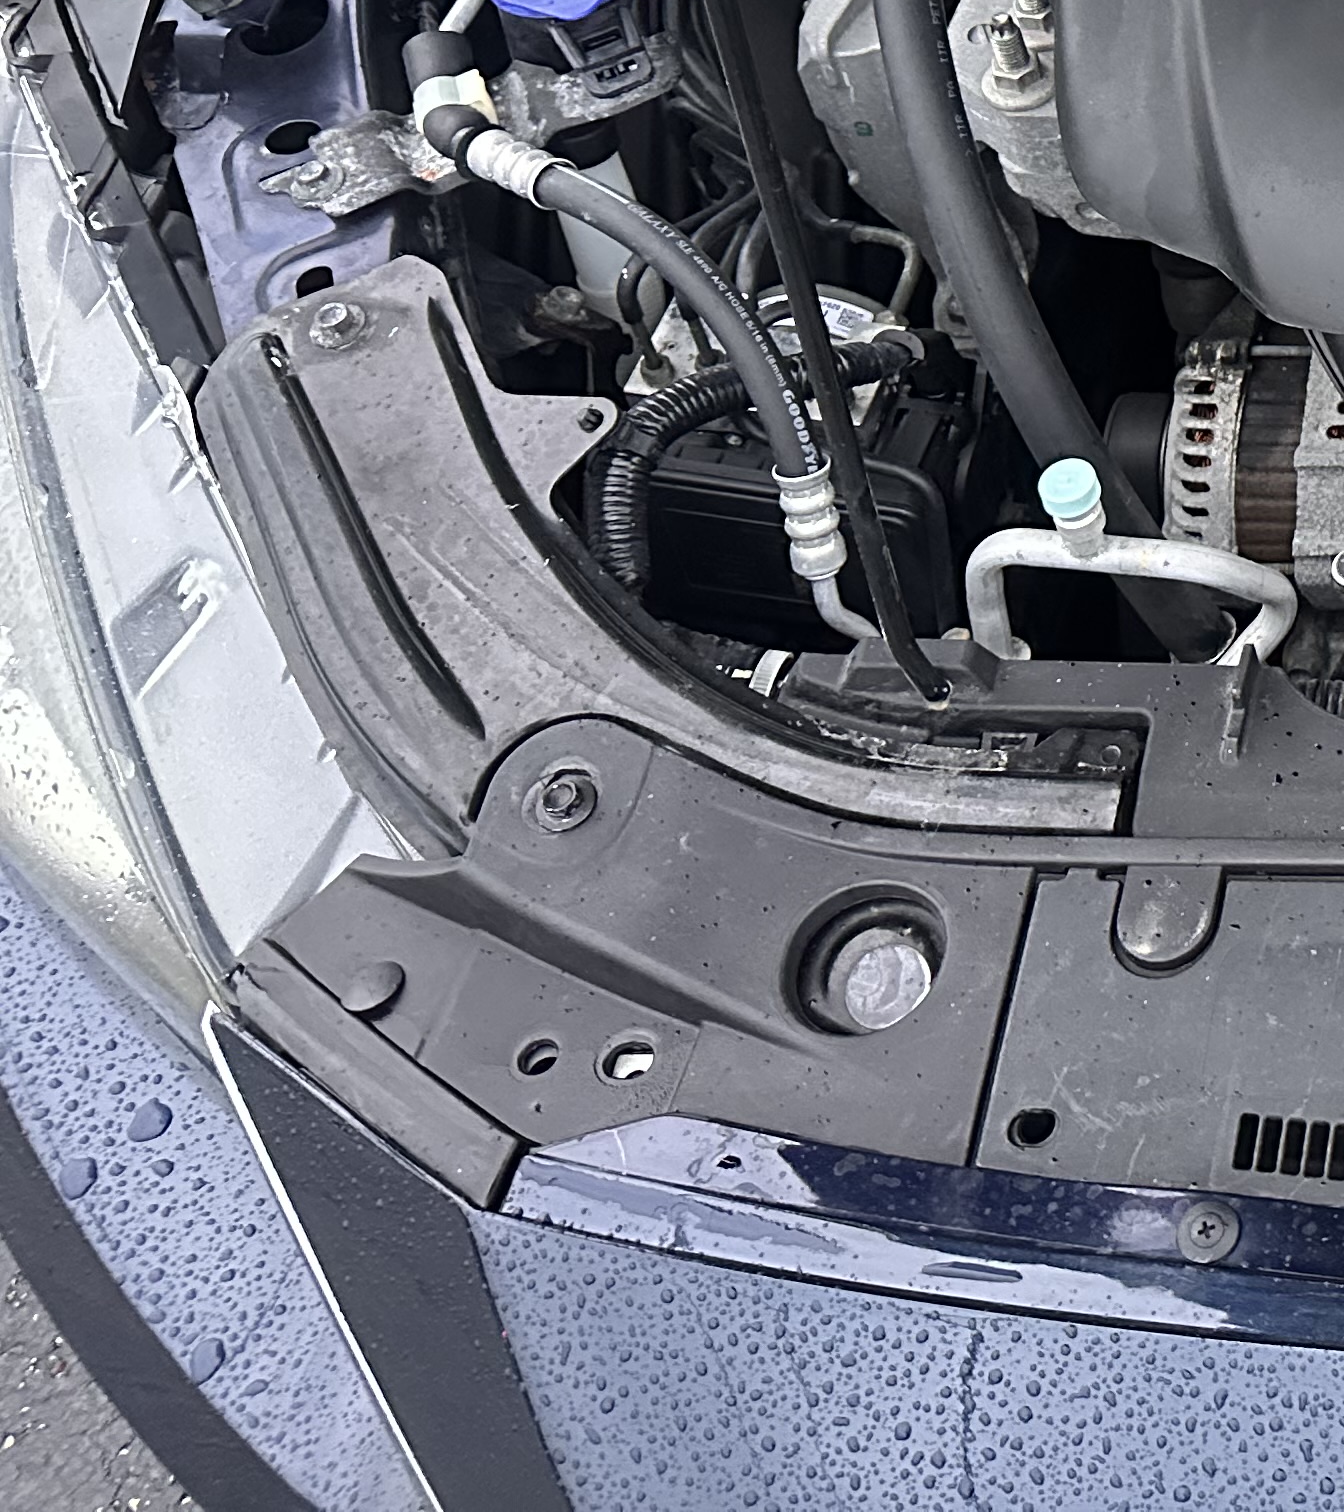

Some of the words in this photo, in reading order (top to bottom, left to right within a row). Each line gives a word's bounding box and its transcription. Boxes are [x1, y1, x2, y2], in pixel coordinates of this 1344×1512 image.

[627, 203, 681, 238] GALAXY
[675, 239, 695, 256] SLE
[724, 291, 748, 320] HOSE
